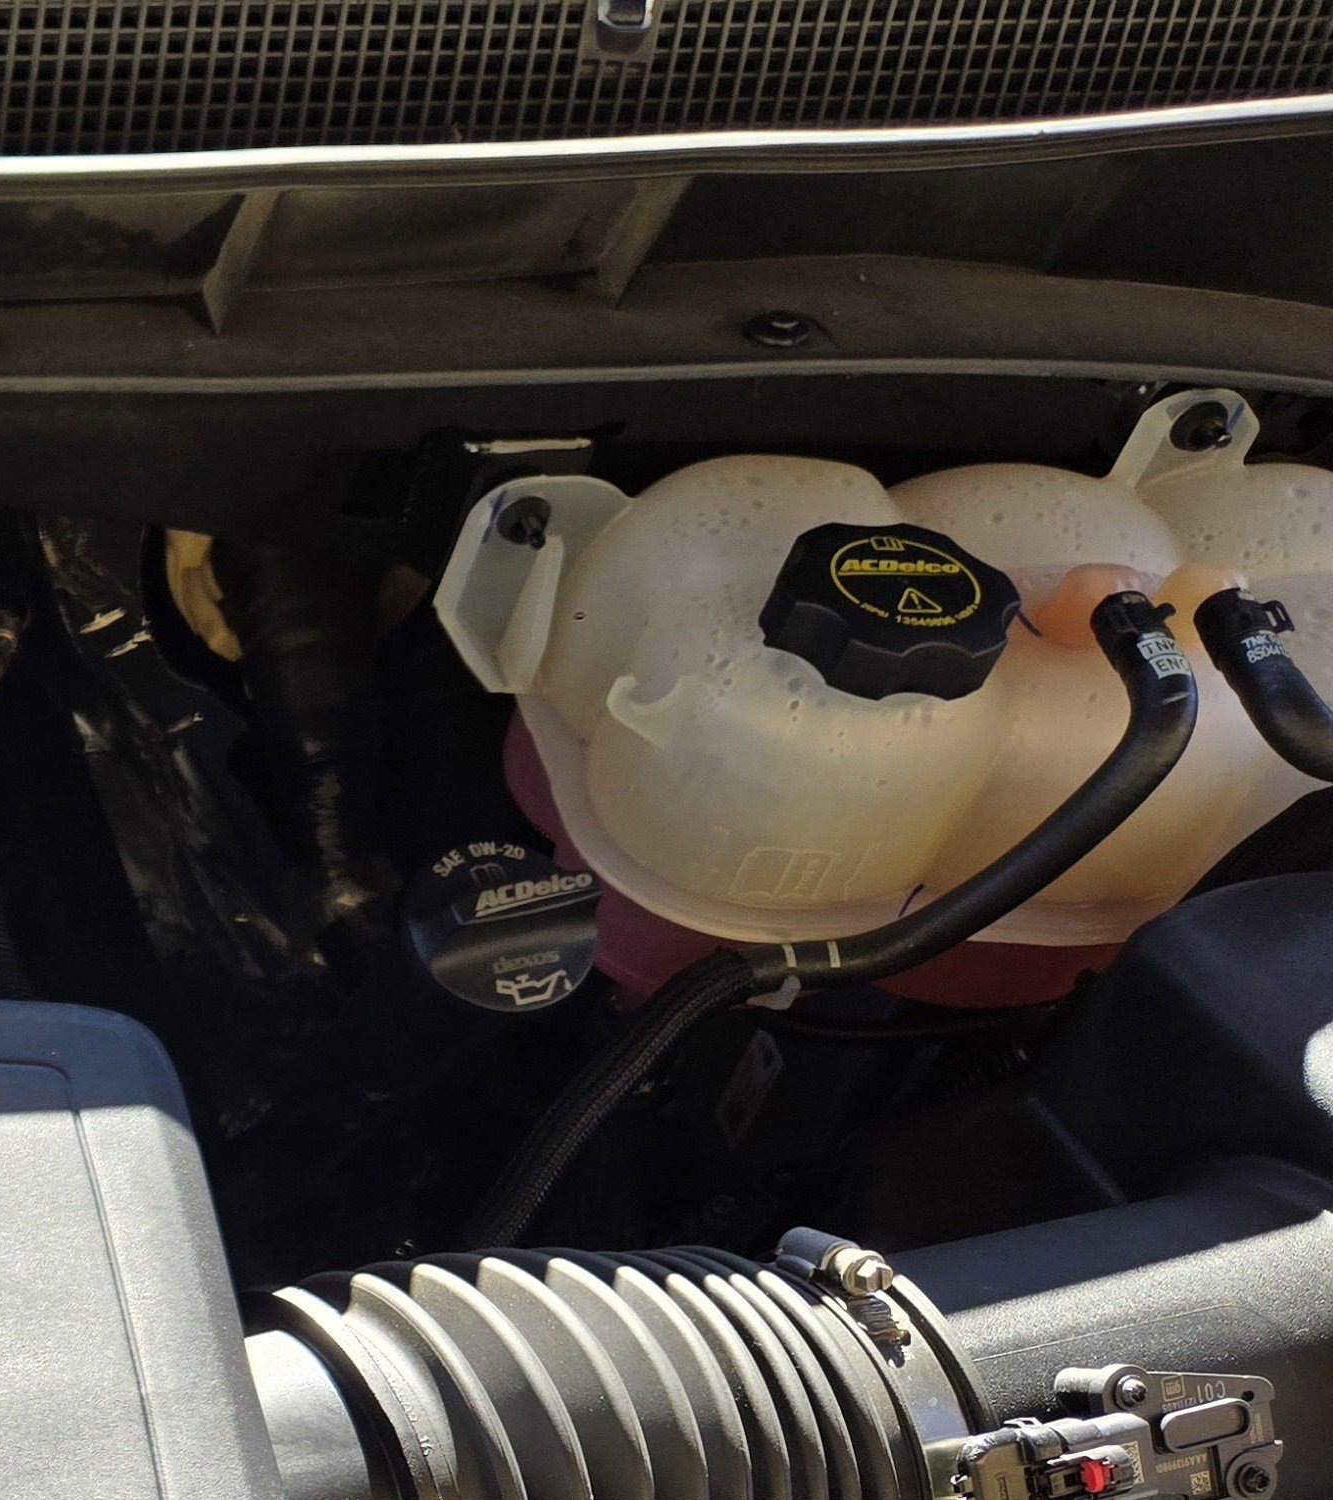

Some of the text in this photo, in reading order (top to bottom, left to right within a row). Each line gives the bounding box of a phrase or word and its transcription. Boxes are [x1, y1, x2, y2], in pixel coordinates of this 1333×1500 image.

[839, 559, 960, 574] ACDelco
[431, 849, 467, 879] SAE
[474, 873, 593, 912] ACDelco
[492, 949, 561, 975] dexos
[1196, 1379, 1226, 1403] C01
